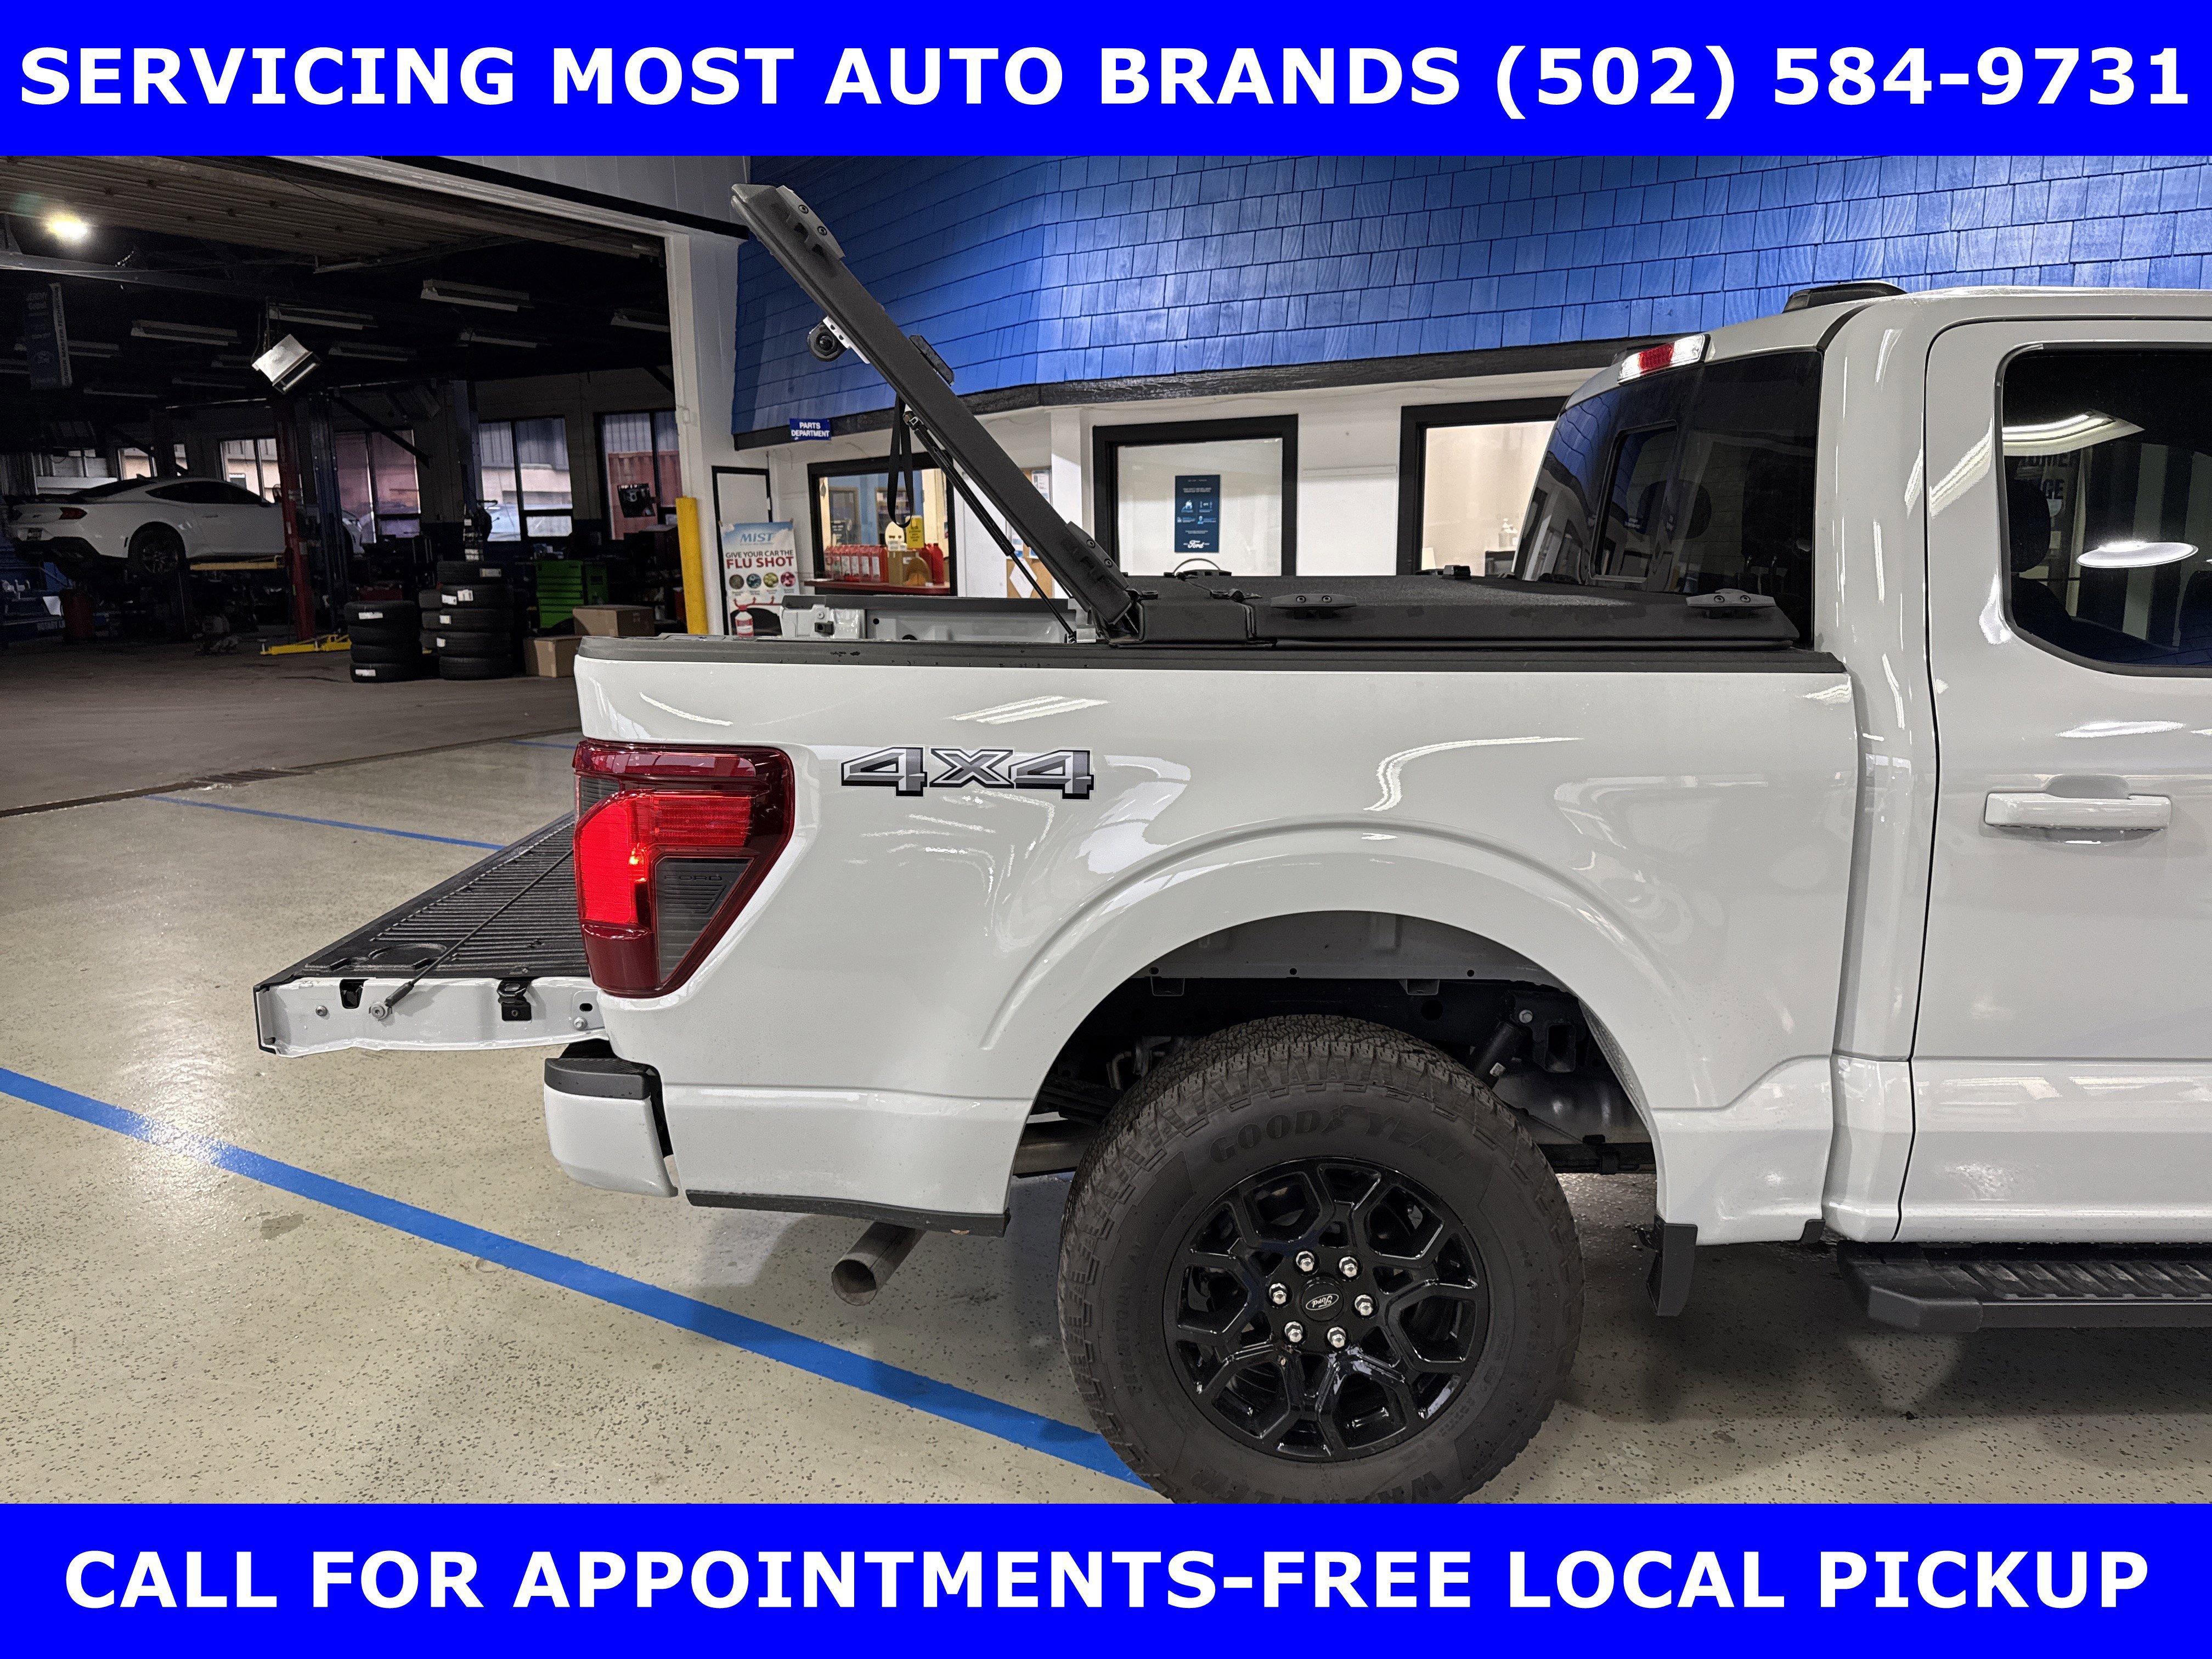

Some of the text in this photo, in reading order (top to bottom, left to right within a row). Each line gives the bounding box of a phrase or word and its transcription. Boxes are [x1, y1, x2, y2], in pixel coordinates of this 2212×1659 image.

[740, 532, 774, 543] MIST
[1187, 539, 1205, 549] Ford
[726, 556, 794, 569] FLU SHOT
[840, 746, 1095, 800] 4X4
[1209, 1104, 1473, 1169] GOODYEAR
[1311, 1295, 1333, 1308] Ford
